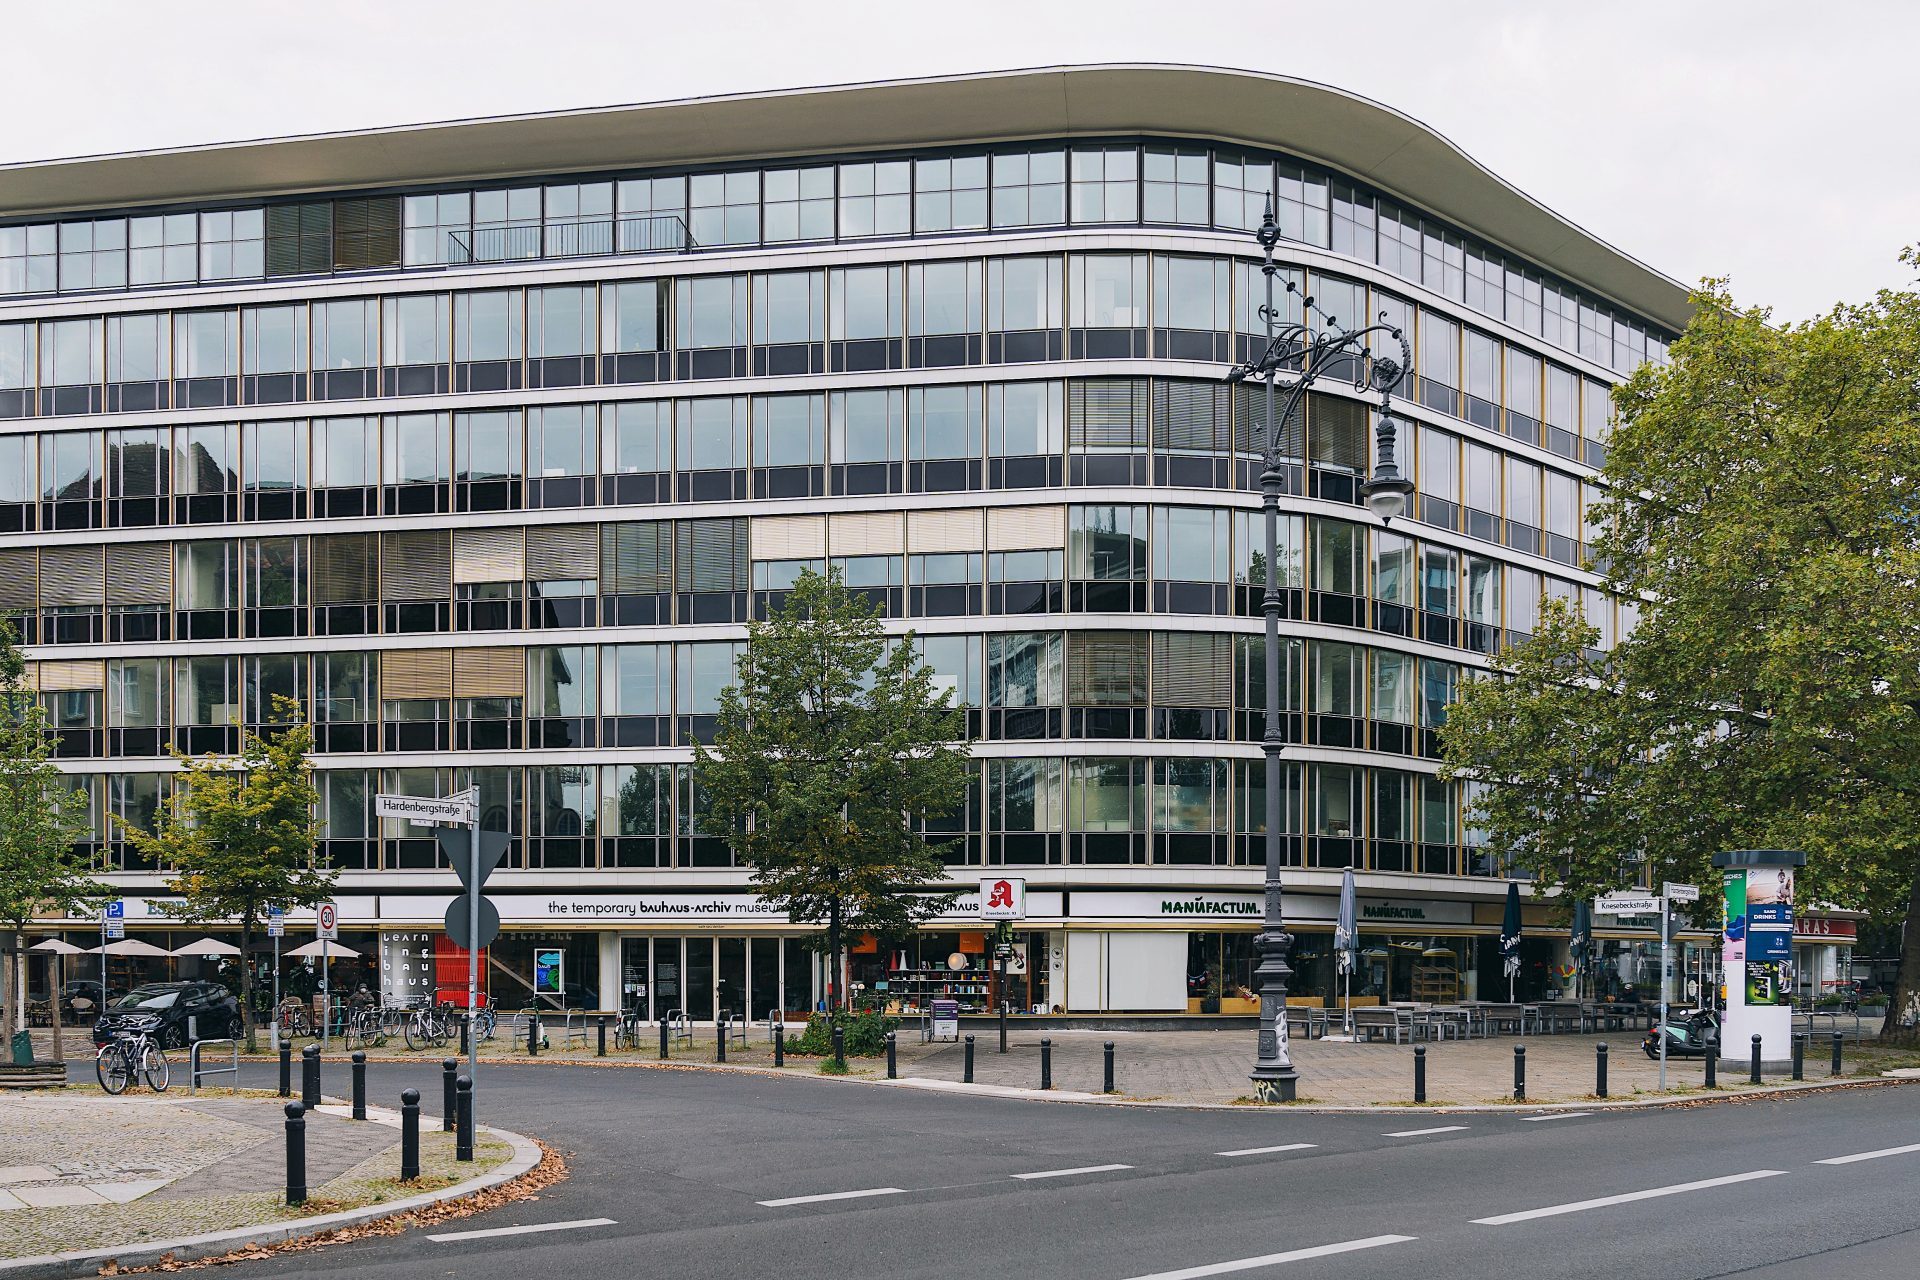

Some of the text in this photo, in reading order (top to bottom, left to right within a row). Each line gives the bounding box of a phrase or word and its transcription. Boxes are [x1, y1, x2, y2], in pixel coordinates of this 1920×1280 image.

[383, 799, 460, 816] Hardenbergstraße
[548, 901, 568, 913] the
[572, 902, 636, 916] temporary
[640, 901, 732, 913] bauhaus-archiv
[1601, 900, 1653, 910] Knesebeckstraße
[323, 911, 332, 923] 30
